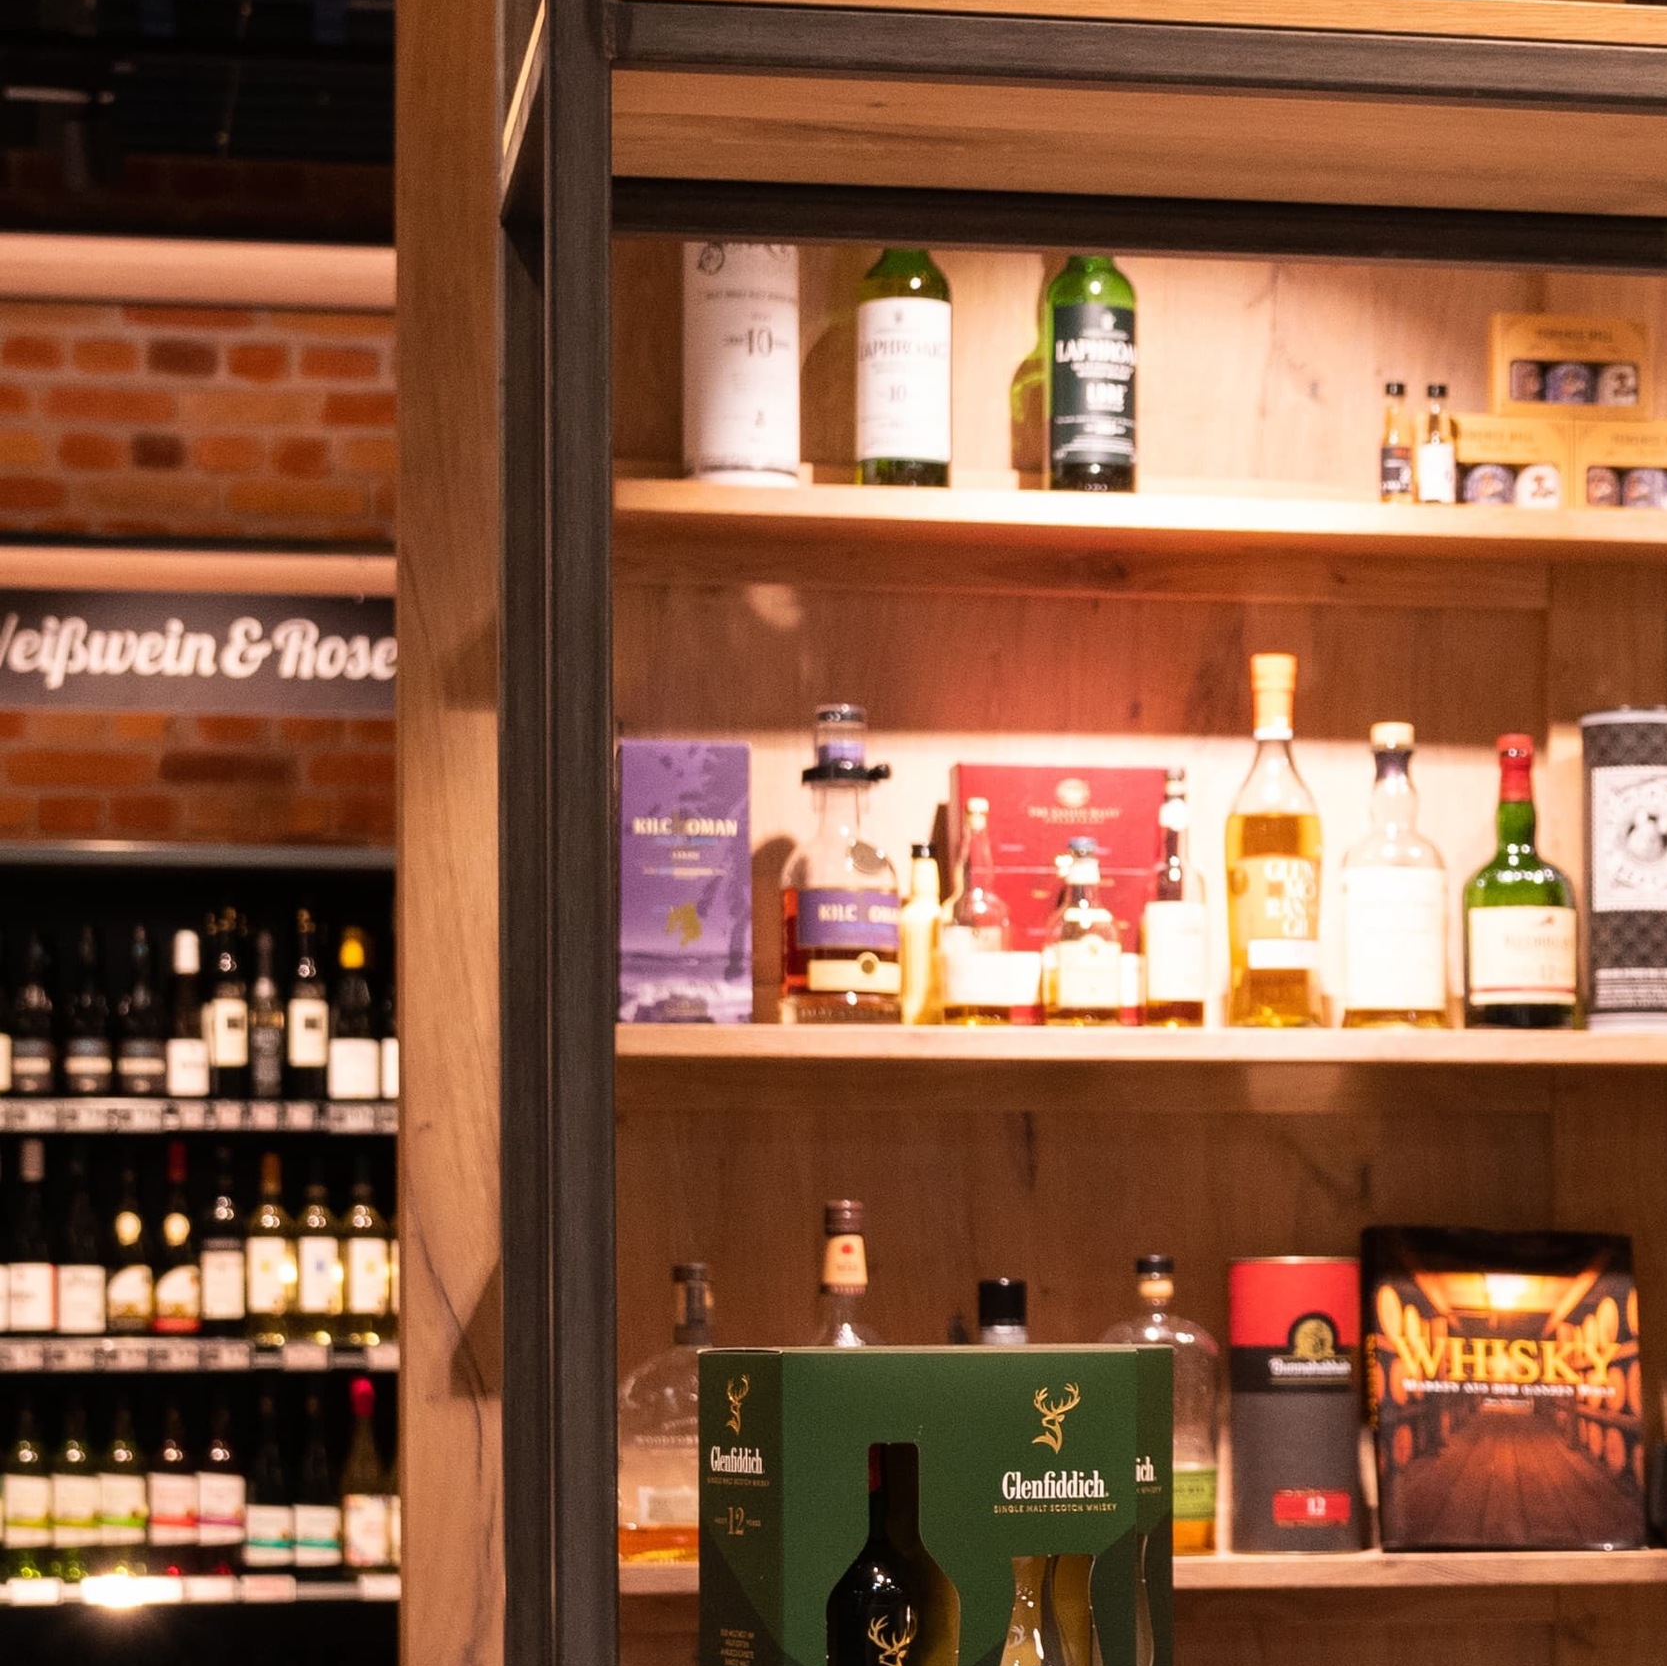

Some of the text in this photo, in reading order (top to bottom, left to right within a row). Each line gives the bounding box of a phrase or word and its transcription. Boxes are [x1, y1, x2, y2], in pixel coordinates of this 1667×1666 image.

[0, 616, 217, 690] eißwein
[633, 816, 738, 837] KILCOMAN
[1397, 1336, 1621, 1384] WHISKY
[710, 1446, 763, 1474] Glenfiddich
[1001, 1470, 1105, 1500] Glenfiddich
[727, 1506, 746, 1536] 12
[993, 1502, 1118, 1514] SINGLE MALT SCOTCH WHISKY
